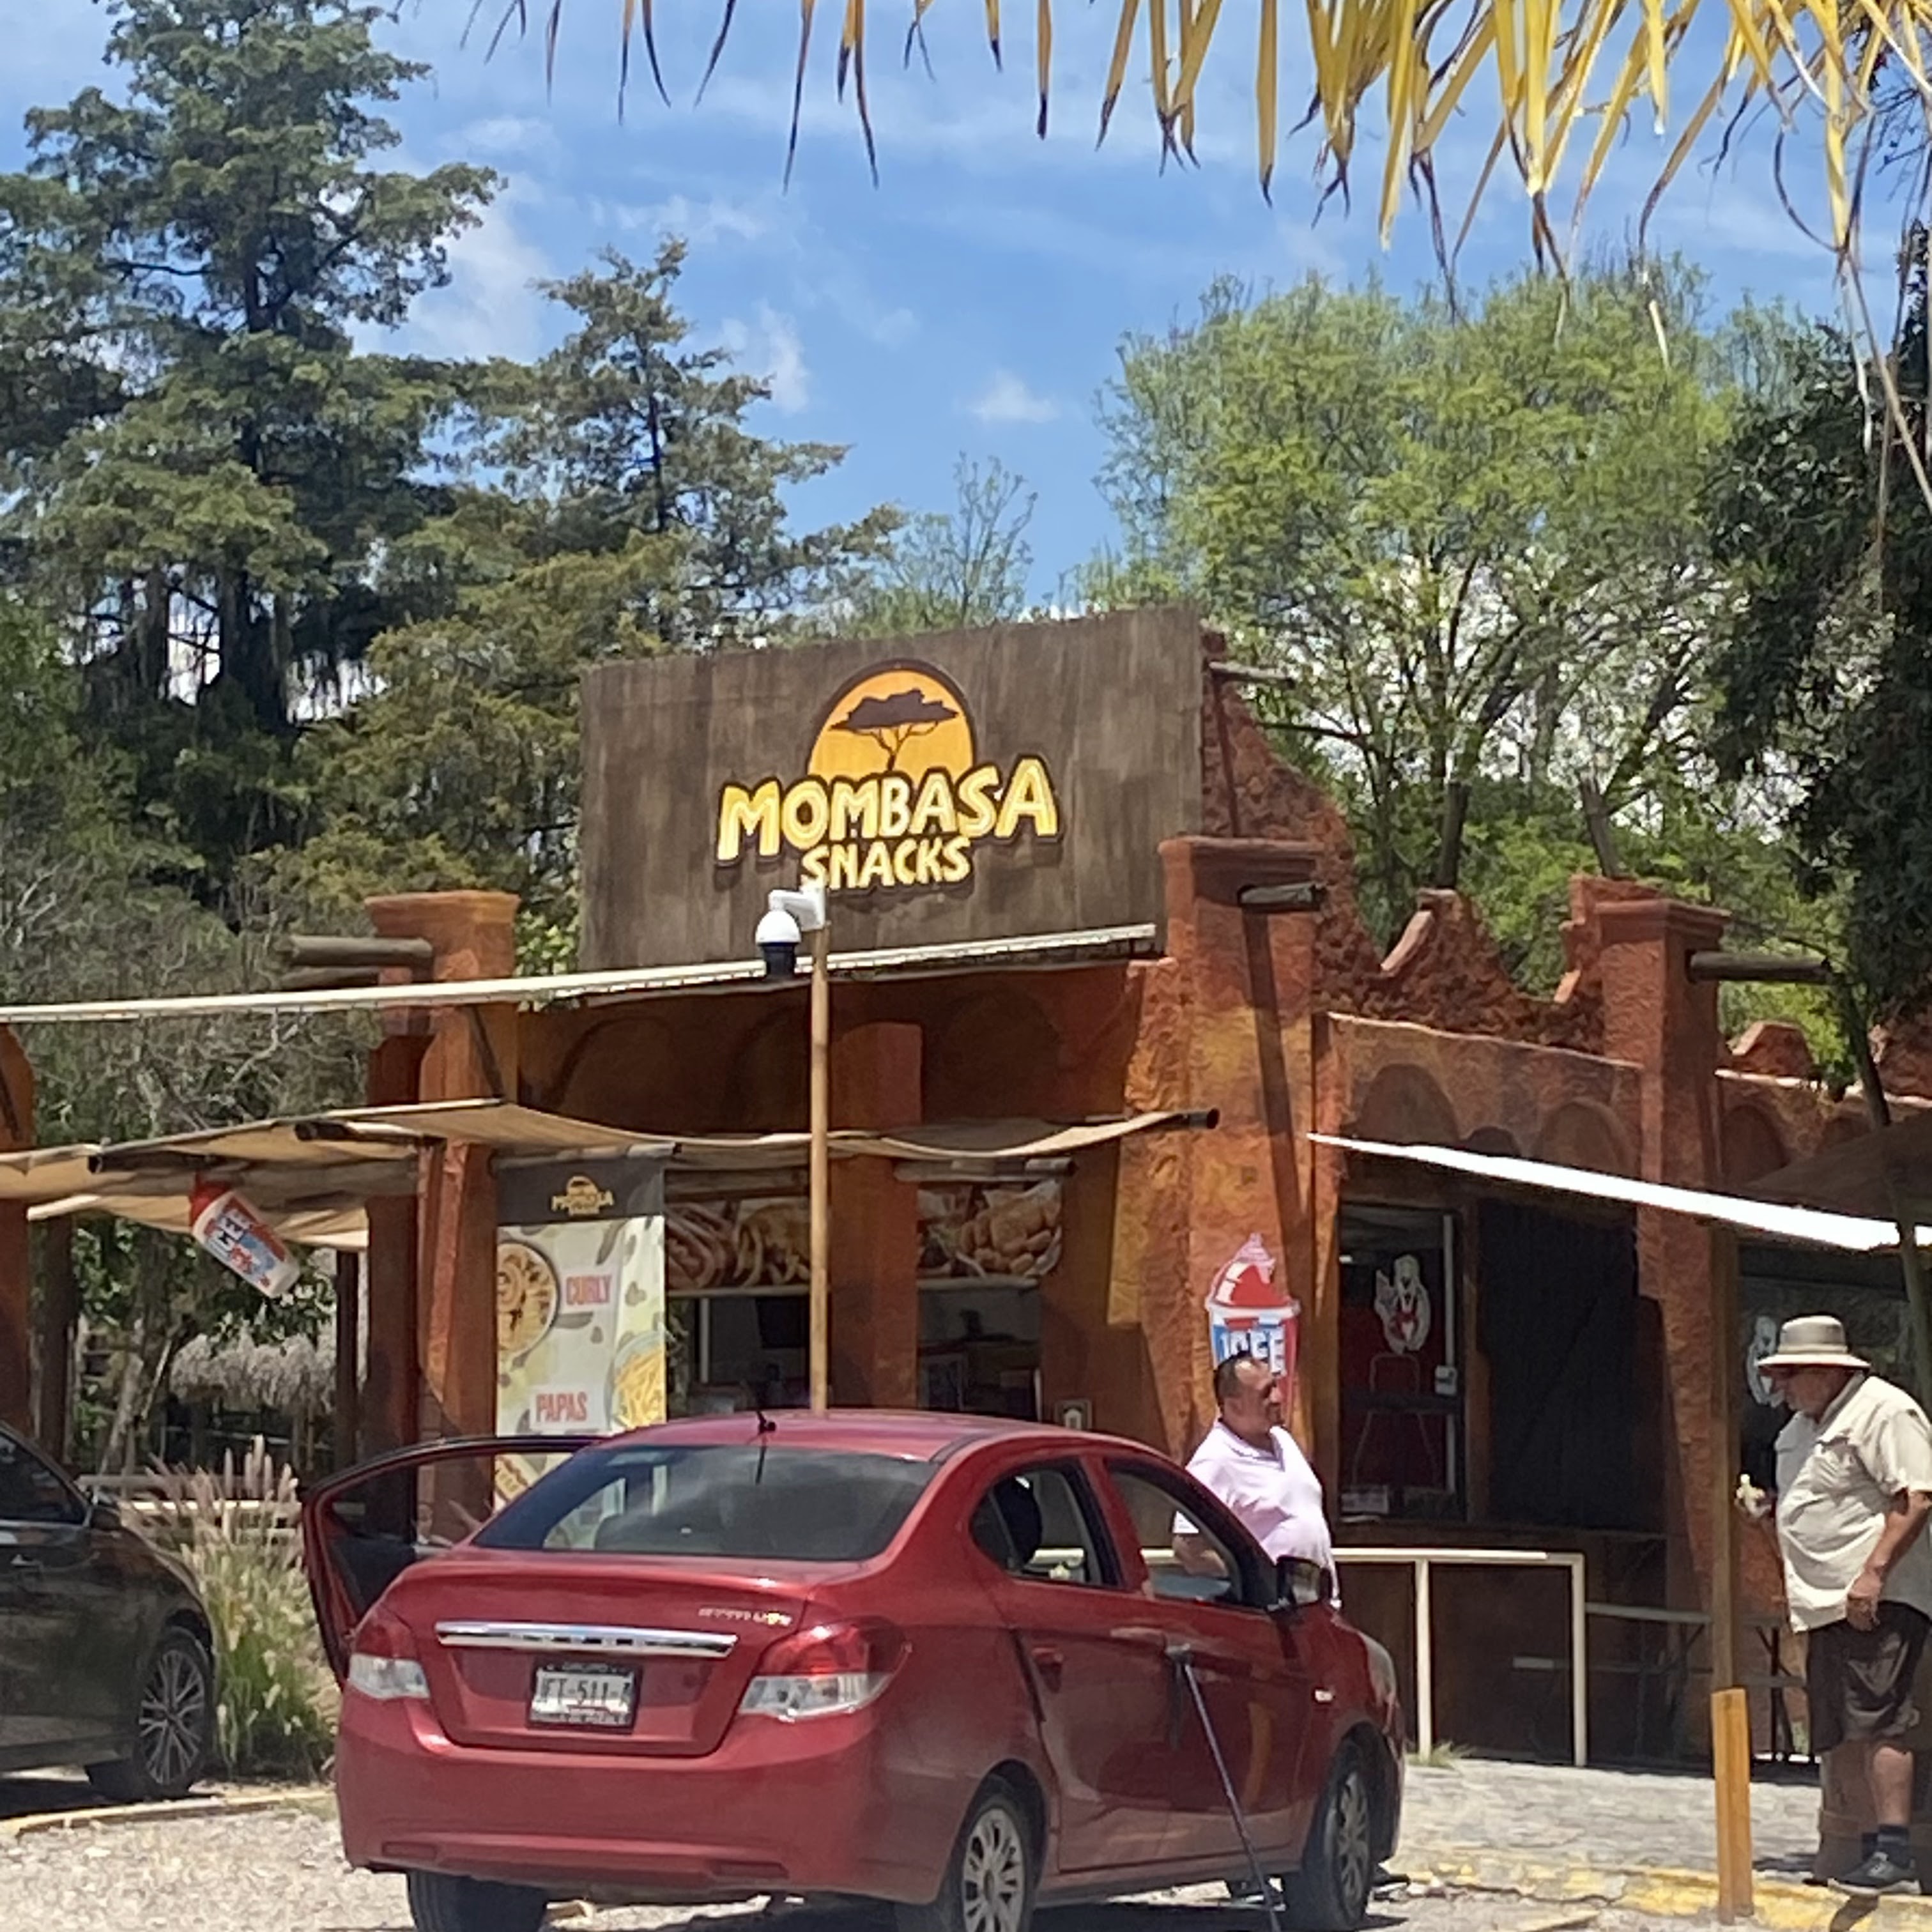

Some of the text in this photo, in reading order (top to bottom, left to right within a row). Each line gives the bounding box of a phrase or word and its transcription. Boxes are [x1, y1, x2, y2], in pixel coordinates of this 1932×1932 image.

[716, 757, 1059, 861] MOMBASA
[800, 836, 971, 890] SNACKS
[566, 1275, 612, 1305] CURLY
[535, 1392, 587, 1423] PAPAS
